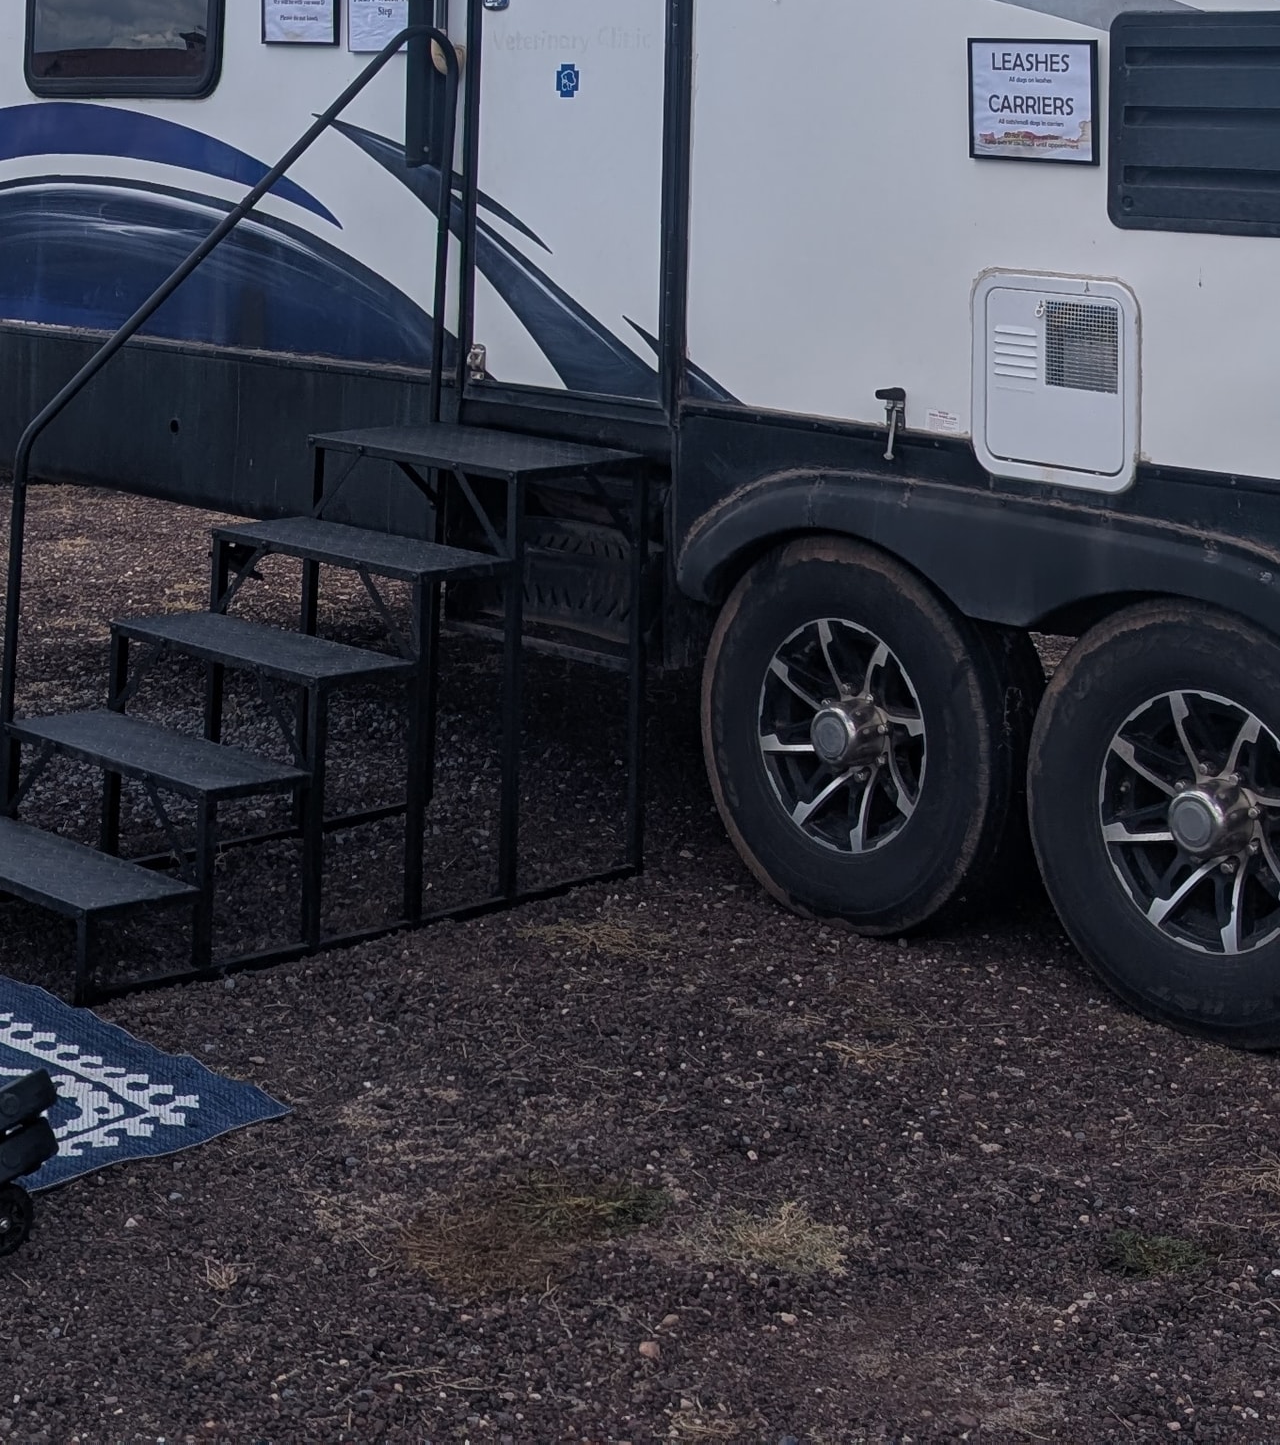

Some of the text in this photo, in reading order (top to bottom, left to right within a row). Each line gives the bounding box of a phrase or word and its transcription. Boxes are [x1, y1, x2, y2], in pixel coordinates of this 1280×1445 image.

[377, 6, 393, 18] Step
[991, 52, 1070, 73] LEASHES
[1016, 76, 1027, 84] dogs
[988, 94, 1074, 116] CARRIERS
